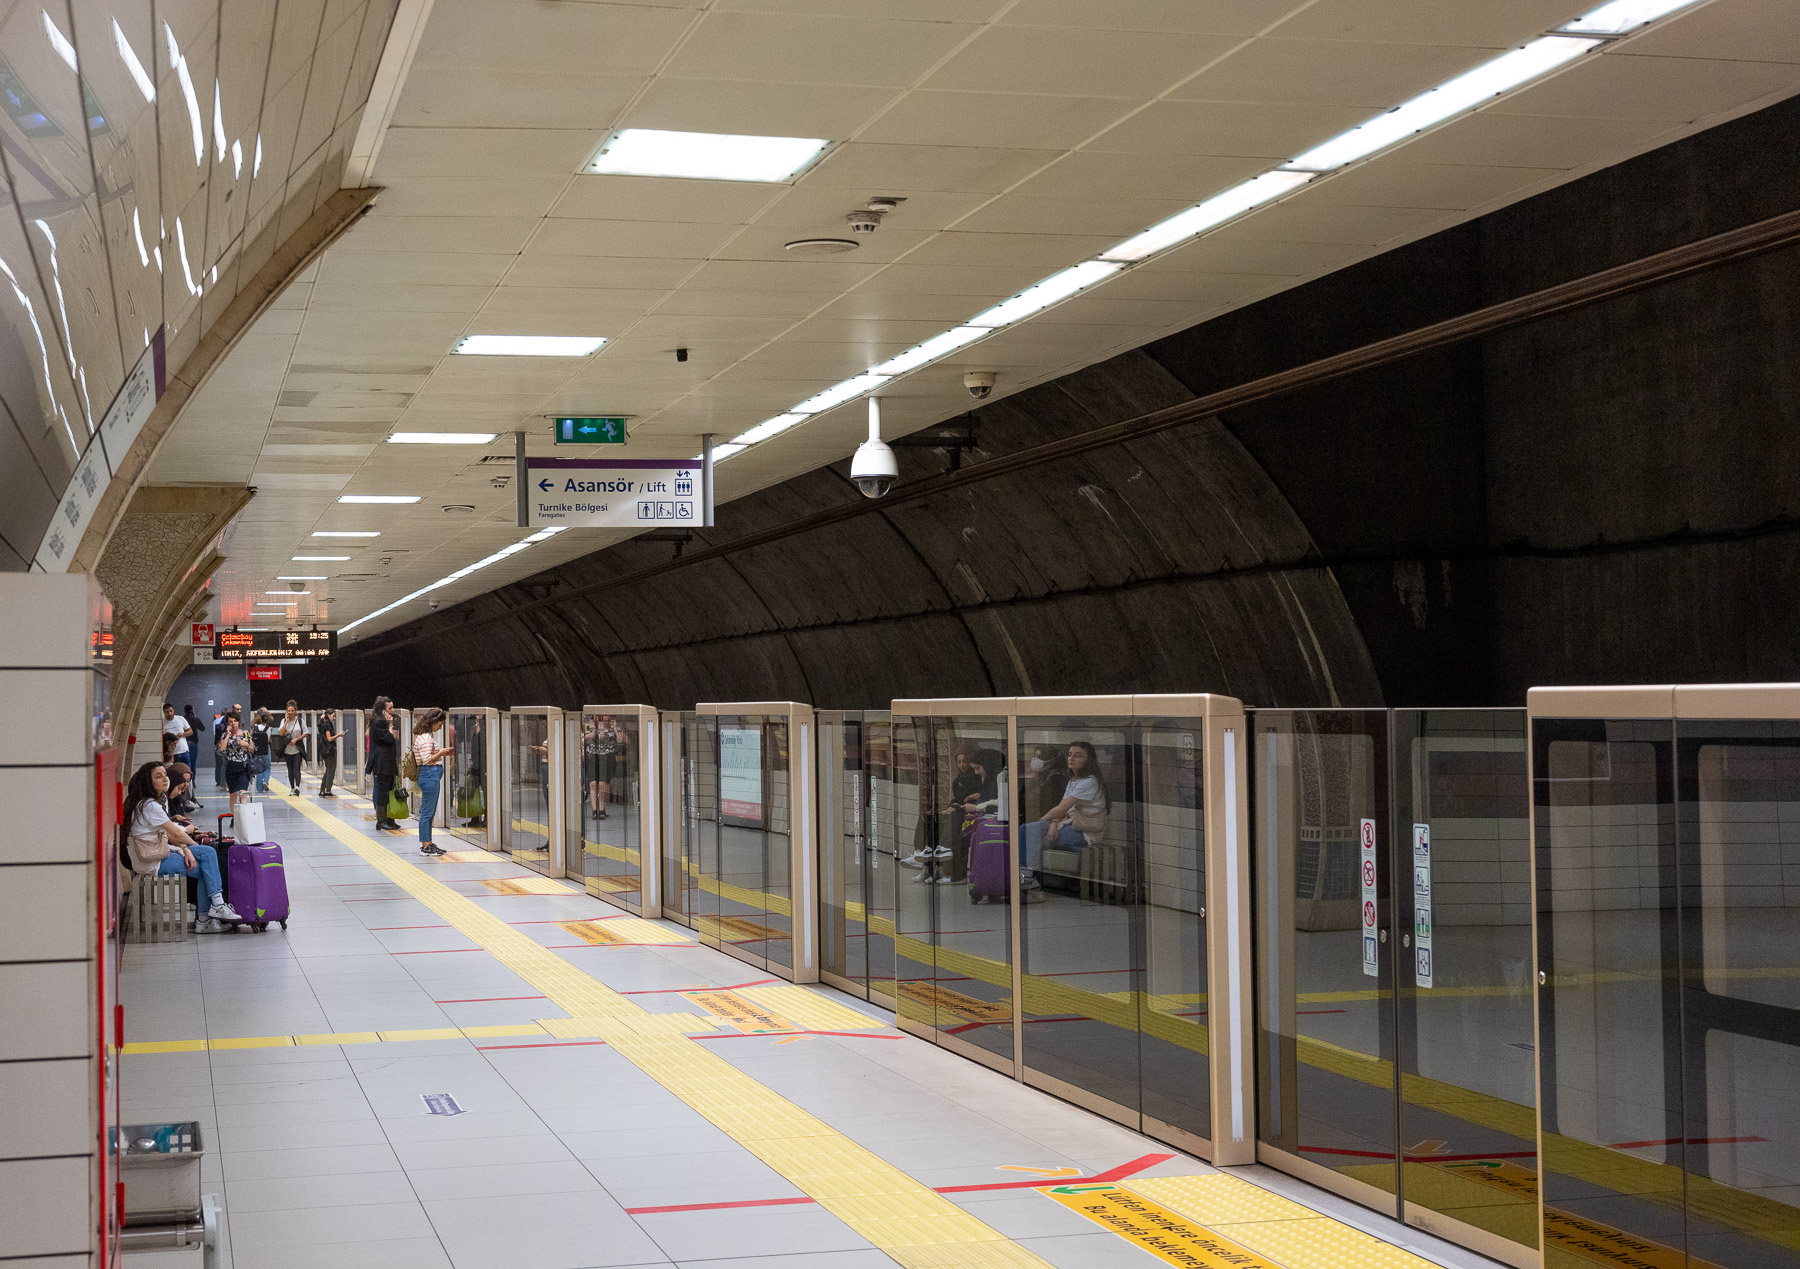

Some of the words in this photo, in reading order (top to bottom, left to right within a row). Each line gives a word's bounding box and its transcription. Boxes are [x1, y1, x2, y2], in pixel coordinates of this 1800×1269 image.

[564, 477, 634, 493] Asansör
[647, 481, 667, 493] Lift
[538, 503, 573, 512] Turnike
[575, 503, 608, 514] Bölgesi
[1083, 1205, 1109, 1214] Bu
[1099, 1214, 1152, 1236] alanda
[1101, 1192, 1148, 1212] Lütfen
[1138, 1211, 1199, 1238] inenlere
[1191, 1239, 1254, 1265] öncelik
